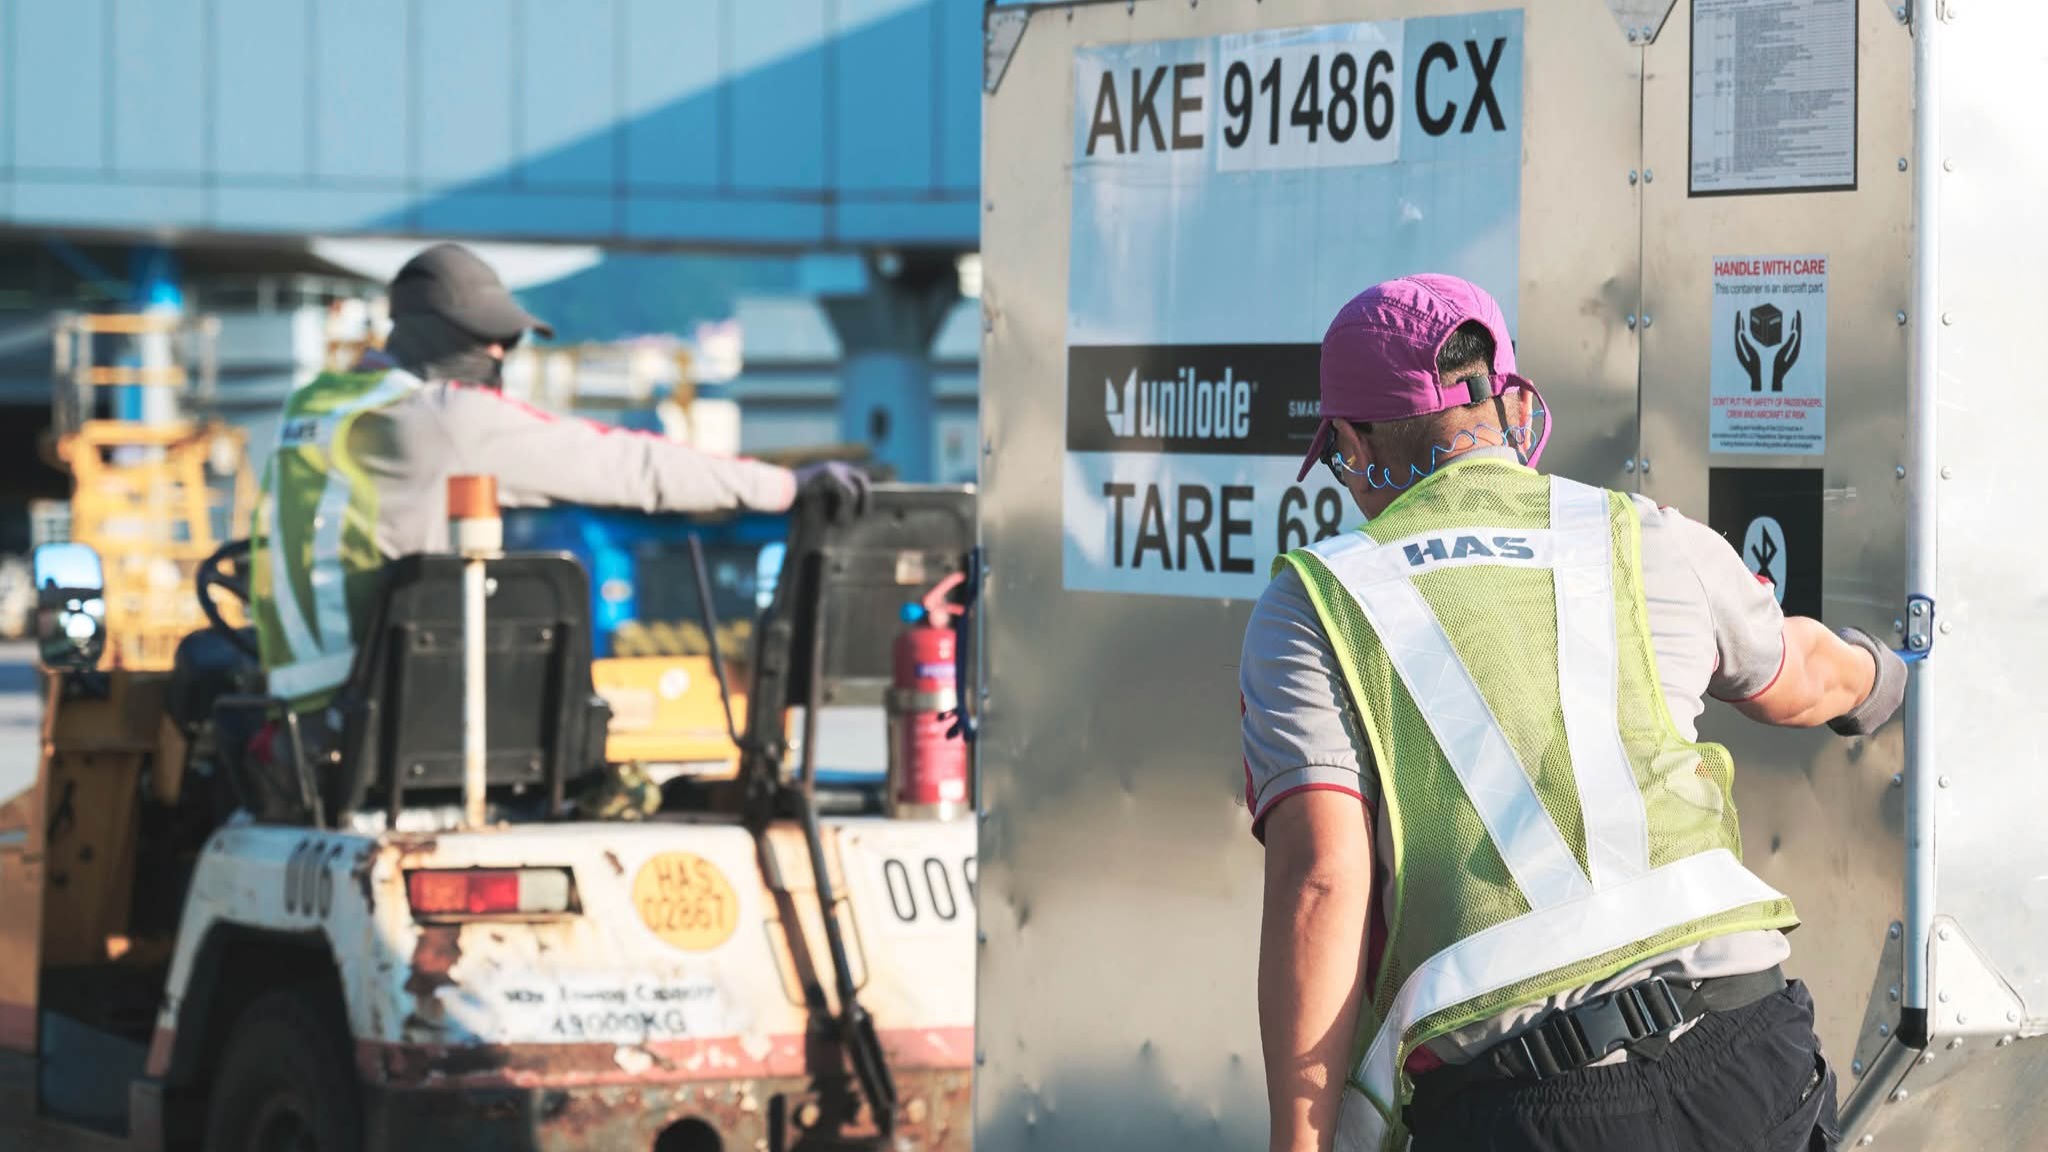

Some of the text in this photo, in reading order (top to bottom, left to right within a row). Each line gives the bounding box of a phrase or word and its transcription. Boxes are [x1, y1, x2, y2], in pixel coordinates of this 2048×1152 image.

[1085, 37, 1508, 156] AKE 91486 CX
[1714, 259, 1825, 276] HANDLE WITH CARE
[1715, 283, 1729, 294] This
[1730, 283, 1763, 294] container
[1764, 284, 1771, 294] is
[1772, 285, 1781, 294] an
[1782, 283, 1807, 294] aircraft
[1140, 367, 1250, 438] unilode
[1104, 482, 1343, 575] TARE 68
[1402, 535, 1535, 567] HAS
[655, 858, 714, 894] HAS
